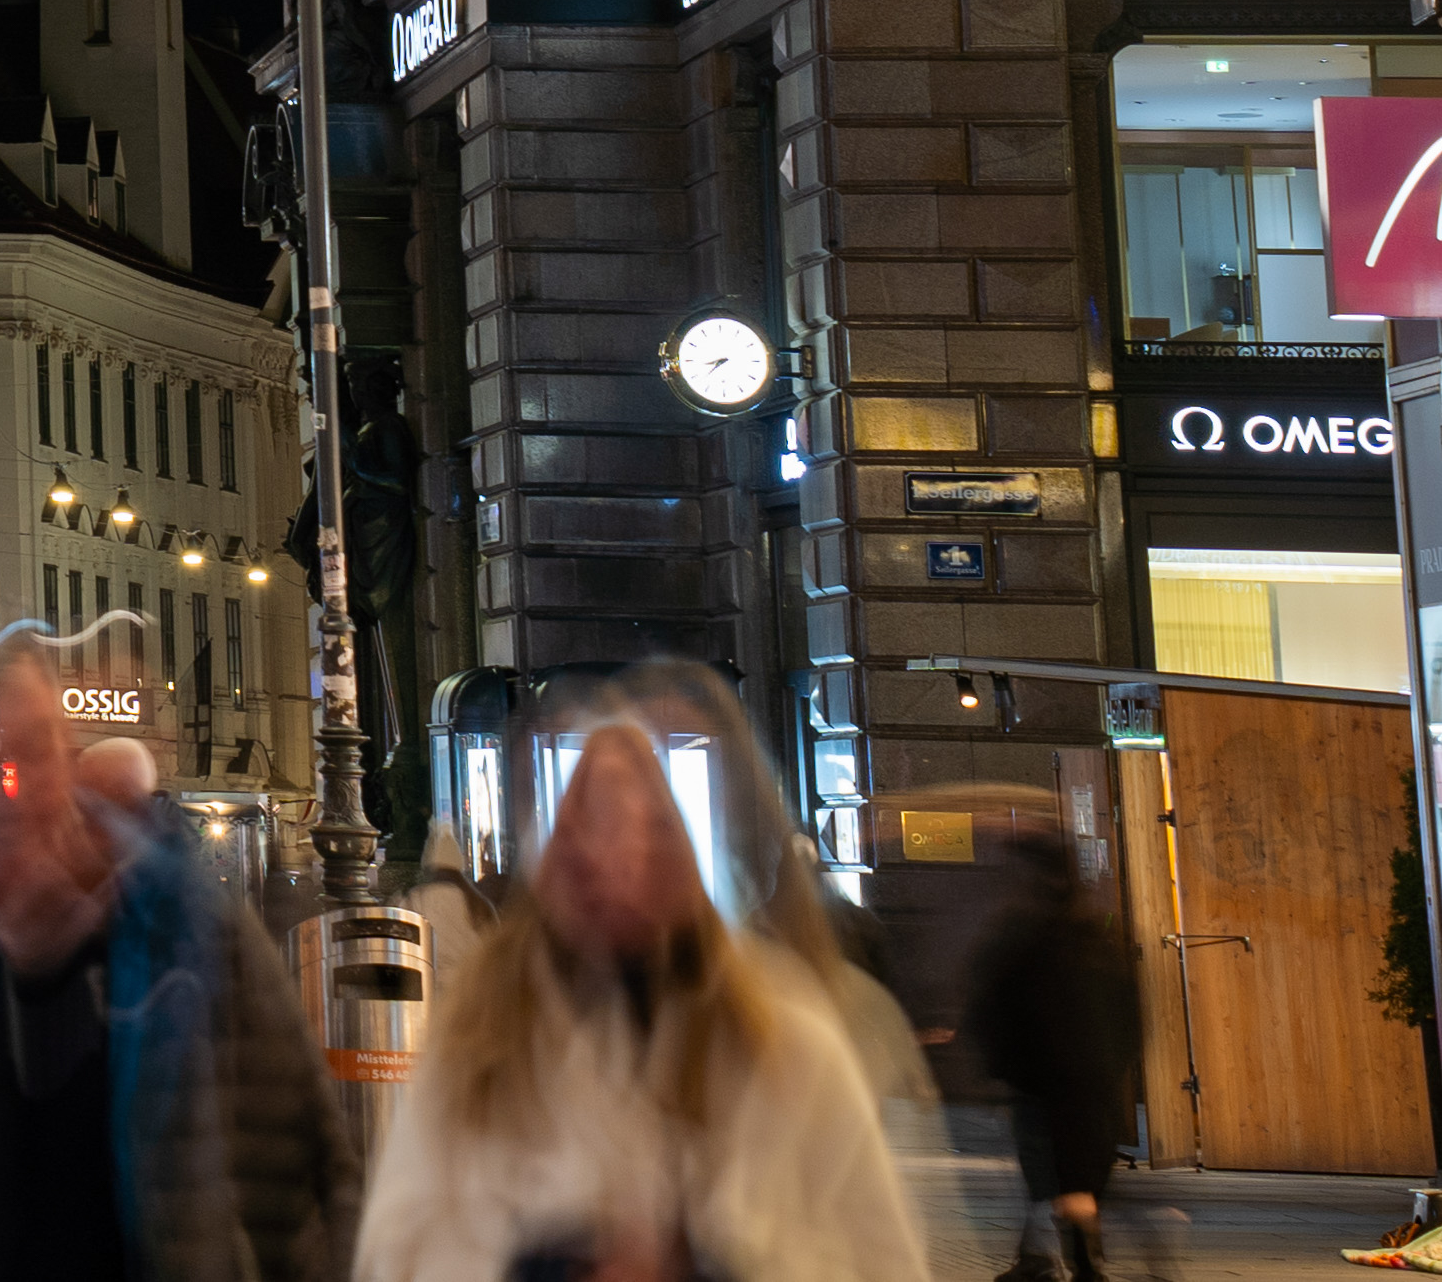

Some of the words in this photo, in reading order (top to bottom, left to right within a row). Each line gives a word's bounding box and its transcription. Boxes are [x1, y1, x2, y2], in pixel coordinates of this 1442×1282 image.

[947, 546, 963, 566] 1
[62, 687, 140, 714] OSSIG
[64, 711, 100, 721] hairstyle
[101, 712, 109, 721] &
[110, 713, 139, 723] beauty
[372, 1069, 394, 1080] 546
